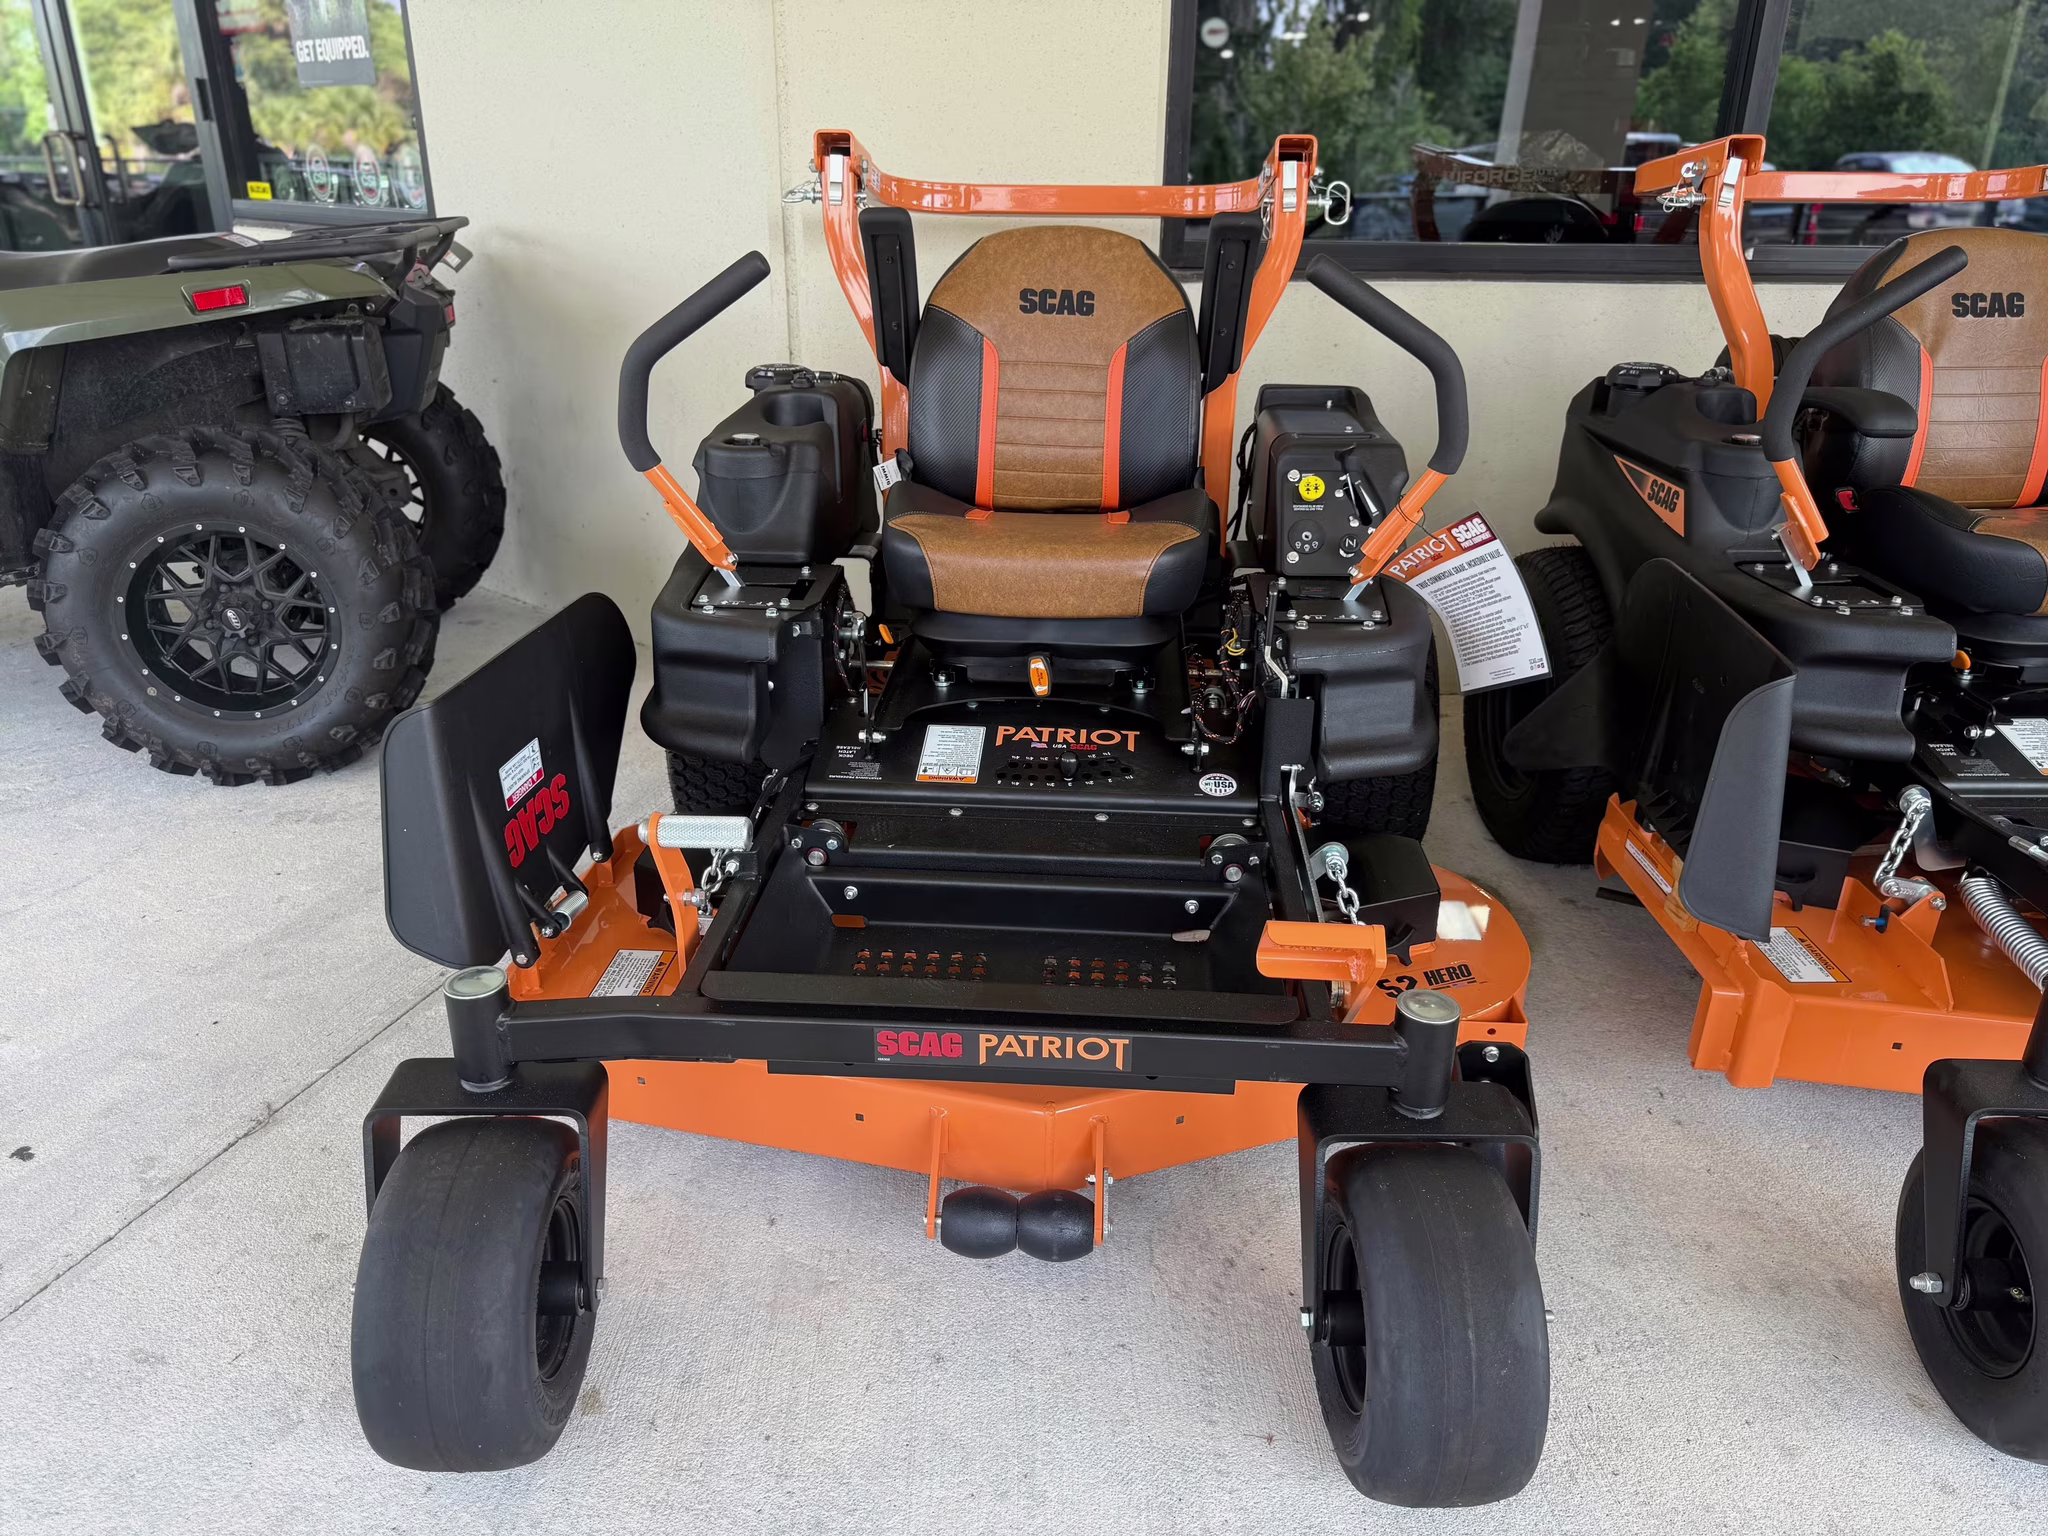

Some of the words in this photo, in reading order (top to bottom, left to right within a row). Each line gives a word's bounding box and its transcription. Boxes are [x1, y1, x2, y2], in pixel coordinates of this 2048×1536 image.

[296, 39, 314, 63] GET
[316, 35, 369, 63] EQUIPPED.
[1019, 288, 1095, 317] SCAG
[1951, 292, 2026, 319] SCAG
[1647, 478, 1680, 513] SCAG
[1346, 538, 1356, 548] N
[1389, 533, 1457, 579] PATRIOT
[1450, 517, 1487, 543] SCAG
[1416, 579, 1430, 591] TRUE
[1427, 567, 1456, 586] COMMERCIAL
[1465, 553, 1492, 571] INCREDIBLE
[995, 725, 1140, 752] PATRIOT
[1070, 743, 1098, 751] SCAG
[511, 779, 533, 803] DANGER
[1213, 780, 1234, 788] USA
[504, 773, 570, 868] SCAG
[1803, 944, 1835, 970] WARNING
[642, 967, 664, 992] WARNING
[1375, 974, 1418, 998] 52
[1422, 963, 1472, 986] HERO
[876, 1030, 963, 1058] SCAG
[978, 1033, 1130, 1071] PATRIOT
